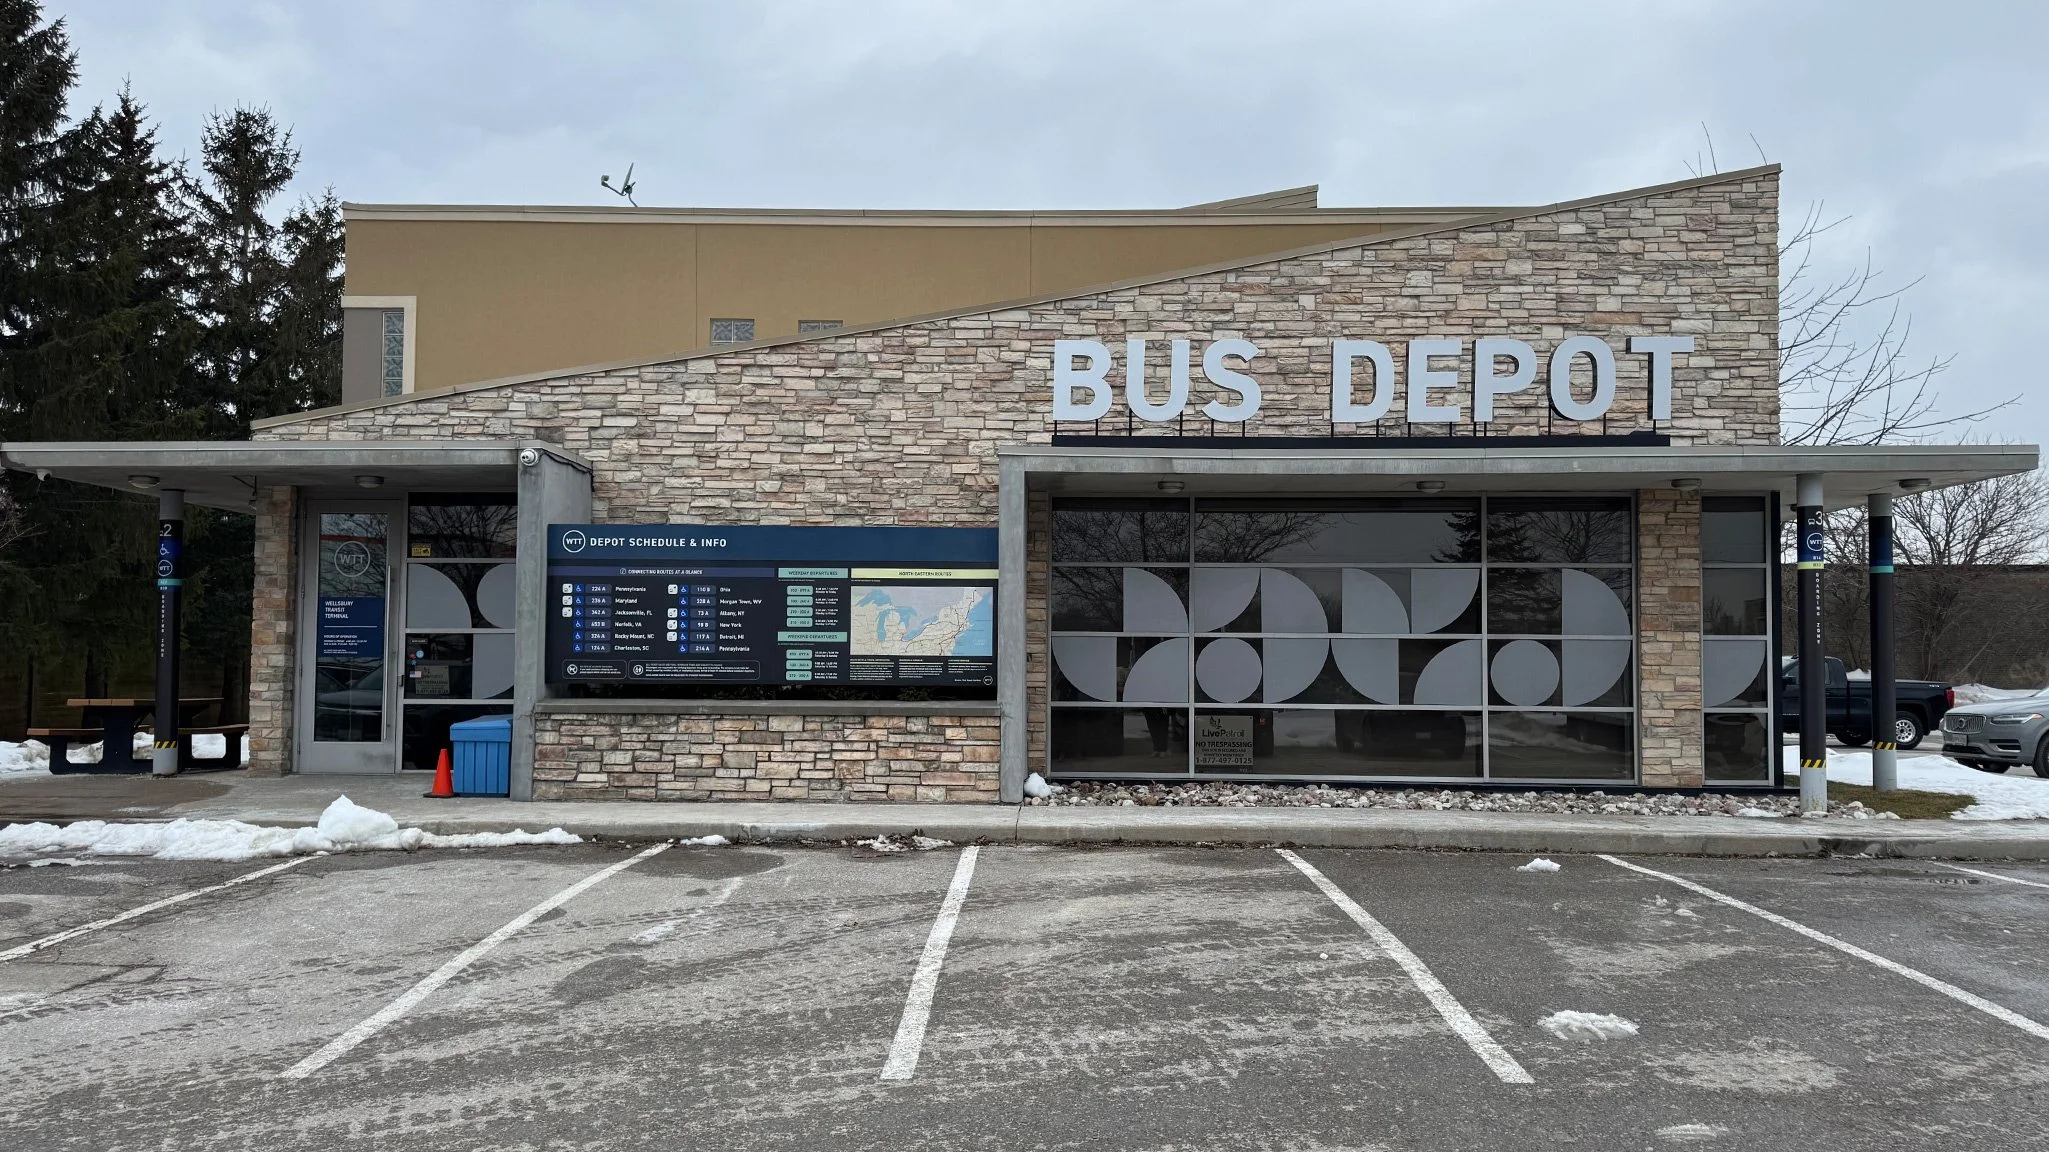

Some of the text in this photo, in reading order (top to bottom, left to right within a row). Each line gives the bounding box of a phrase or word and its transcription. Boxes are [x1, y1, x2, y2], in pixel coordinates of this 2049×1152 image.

[1053, 336, 1695, 423] BUS DEPOT
[1816, 511, 1823, 526] 3
[164, 524, 172, 536] 2
[590, 538, 625, 547] DEPOT
[629, 538, 686, 547] SCHEDULE
[690, 538, 697, 547] &
[701, 539, 727, 548] INFO
[340, 554, 365, 564] WTT
[1202, 729, 1244, 737] LivePatrol
